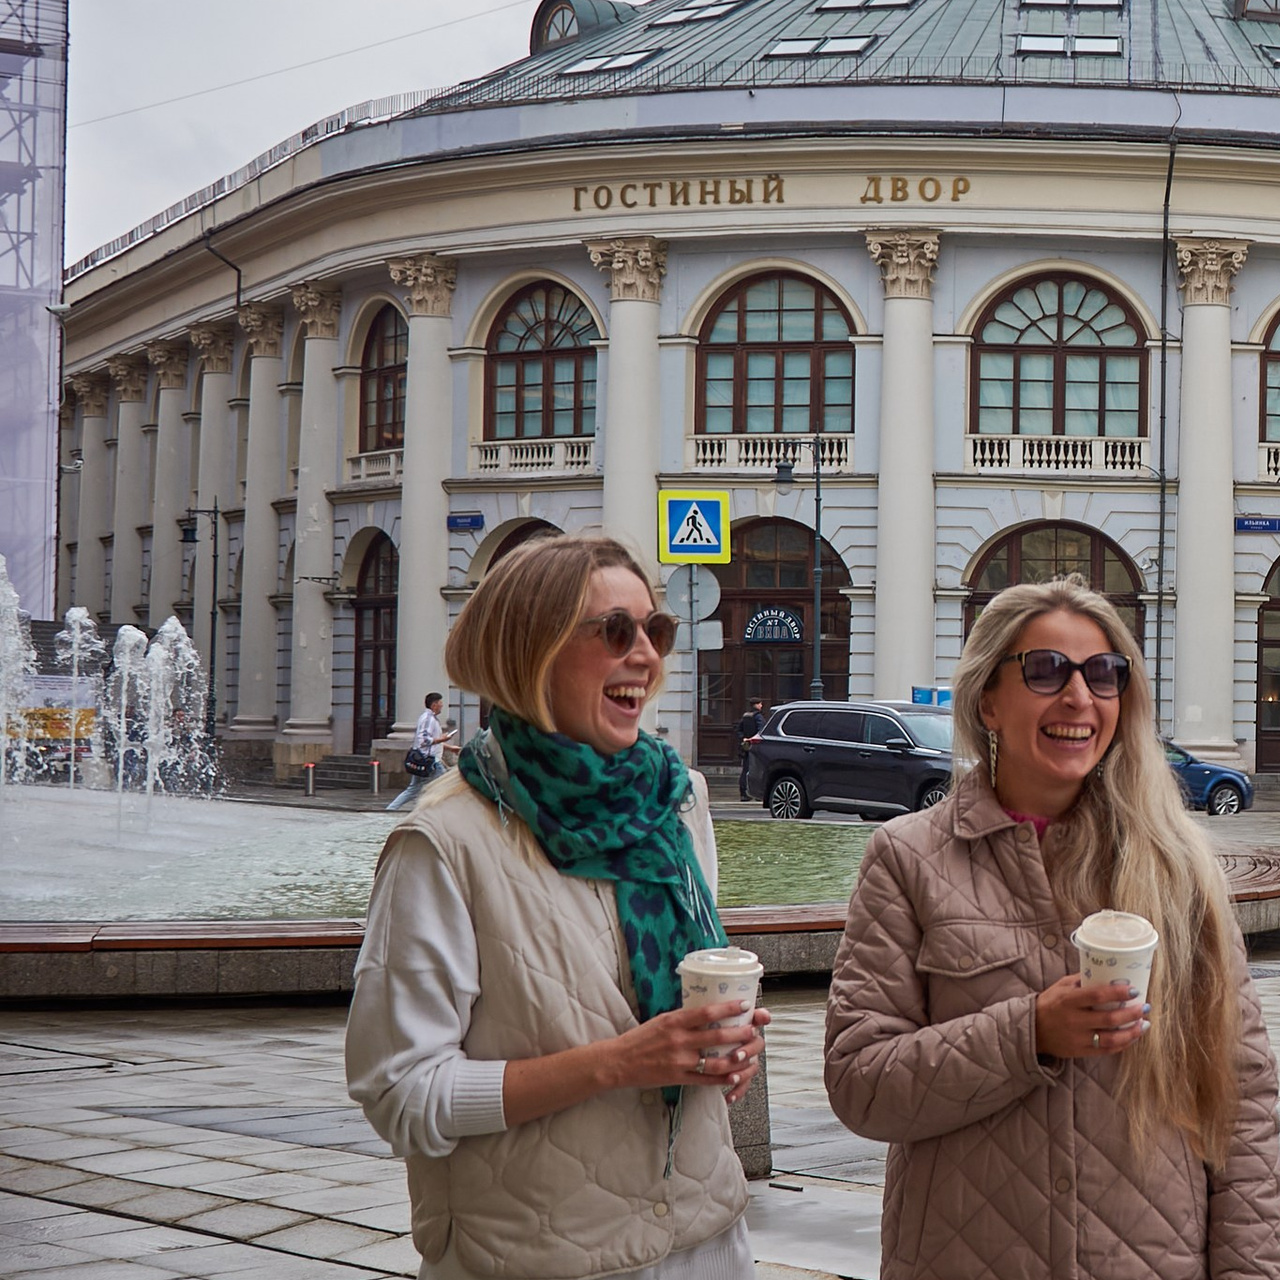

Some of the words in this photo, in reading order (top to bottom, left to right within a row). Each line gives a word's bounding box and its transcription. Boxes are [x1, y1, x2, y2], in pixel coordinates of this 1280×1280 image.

[573, 173, 784, 211] ГОСТИНЫЙ
[860, 176, 971, 204] ДВОР
[745, 609, 786, 639] ГОСТИНЫЙ
[786, 616, 801, 640] ДВОР
[757, 625, 789, 639] ВХОД
